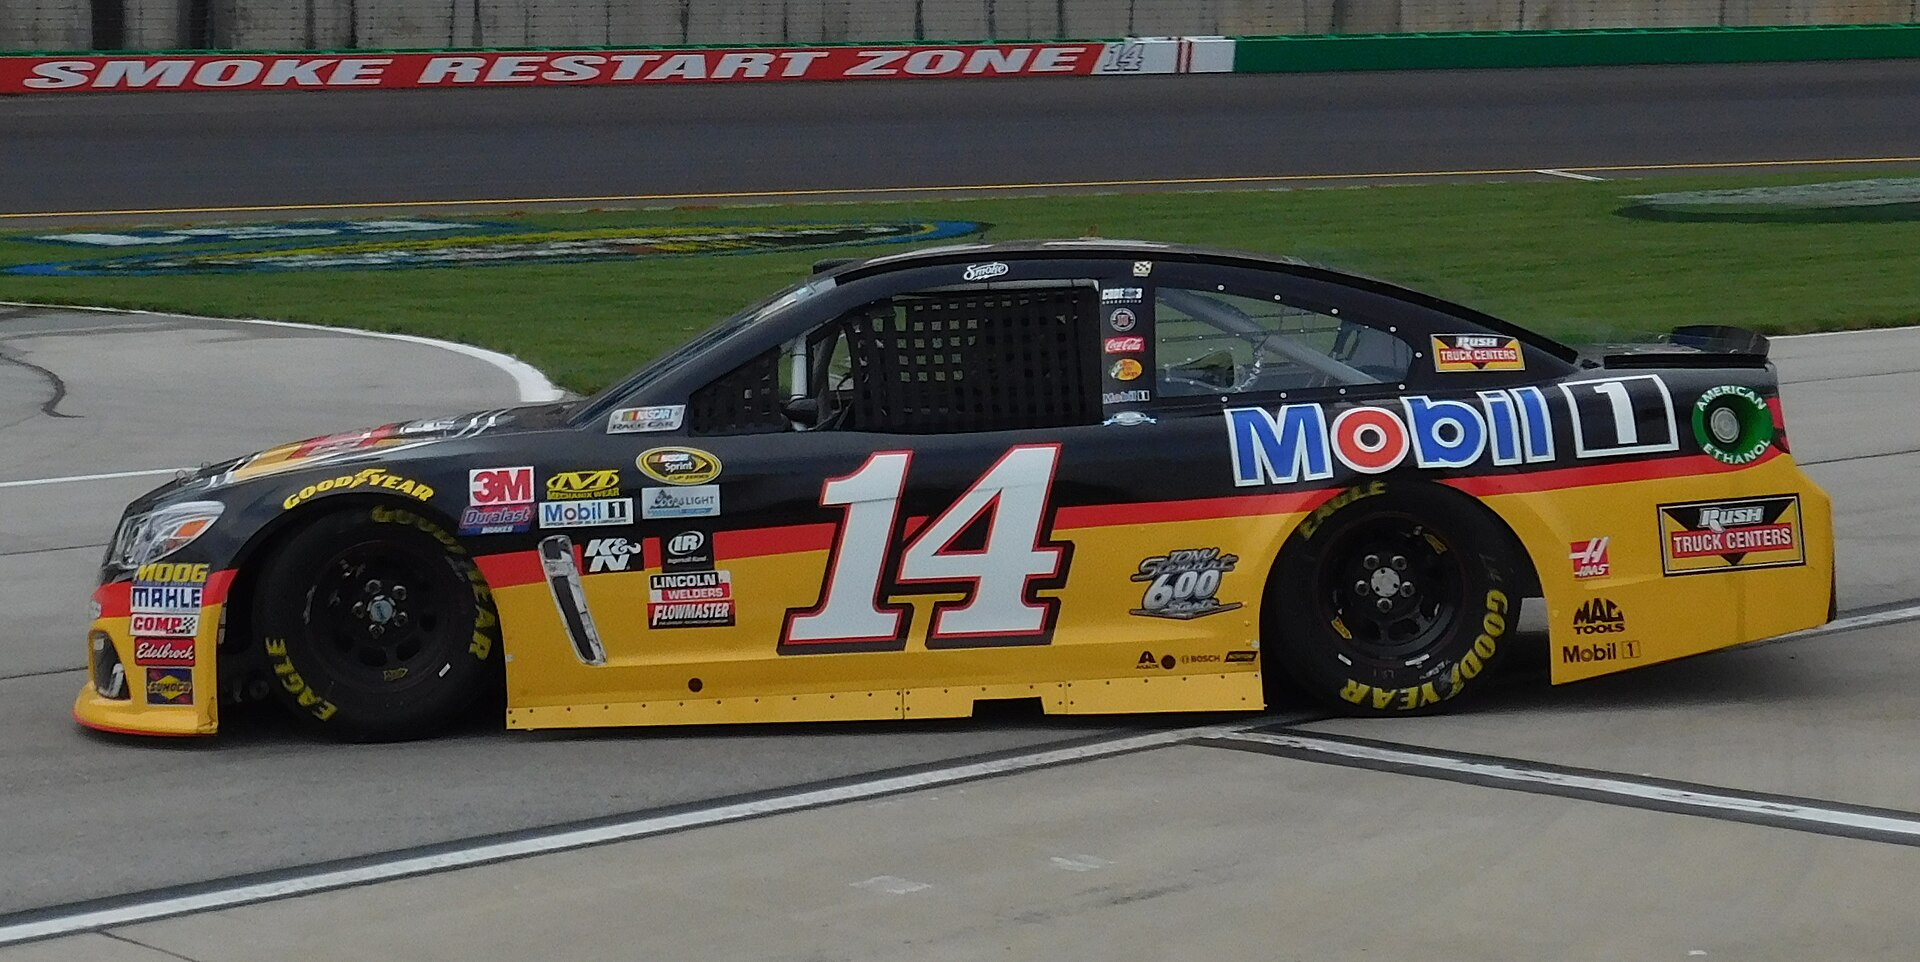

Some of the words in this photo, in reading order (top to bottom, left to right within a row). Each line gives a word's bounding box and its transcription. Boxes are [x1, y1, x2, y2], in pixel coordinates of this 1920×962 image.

[1103, 43, 1145, 71] 14
[23, 59, 392, 88] SMOKE
[417, 51, 829, 83] RESTART
[843, 47, 1087, 76] ZONE
[964, 262, 1008, 280] Smoke
[1441, 351, 1472, 360] TRUCK
[1474, 350, 1516, 360] CENTERS
[1697, 385, 1767, 411] AMERICAN
[1225, 387, 1555, 487] Mobil
[1703, 440, 1771, 464] ETHANOL
[664, 462, 693, 473] Sprint
[283, 468, 436, 511] GOODYEAR
[473, 469, 531, 502] 3M
[547, 490, 592, 499] MECHANIX
[593, 487, 619, 498] WEAR
[686, 496, 714, 505] LIGHT
[463, 507, 530, 525] Duralast
[545, 503, 602, 522] Mobil
[675, 536, 698, 551] IR
[777, 442, 1075, 656] 14
[1674, 534, 1722, 552] TRUCK
[1726, 528, 1792, 548] CENTERS
[134, 564, 209, 583] MOOG
[653, 574, 716, 588] LINCOLN
[132, 588, 201, 608] MAHLE
[668, 588, 723, 600] WELDERS
[1143, 570, 1220, 609] 600
[653, 602, 730, 626] FLOWMASTER
[1573, 598, 1624, 625] MAC
[133, 616, 182, 631] COMP
[1573, 623, 1625, 635] TOOLS
[136, 642, 195, 660] Edelbrock
[1190, 655, 1220, 663] BOSCH
[1339, 589, 1508, 710] GOODYEAR
[1562, 643, 1616, 663] Mobil
[149, 681, 192, 692] SUNOCO
[264, 636, 338, 722] EAGLE
